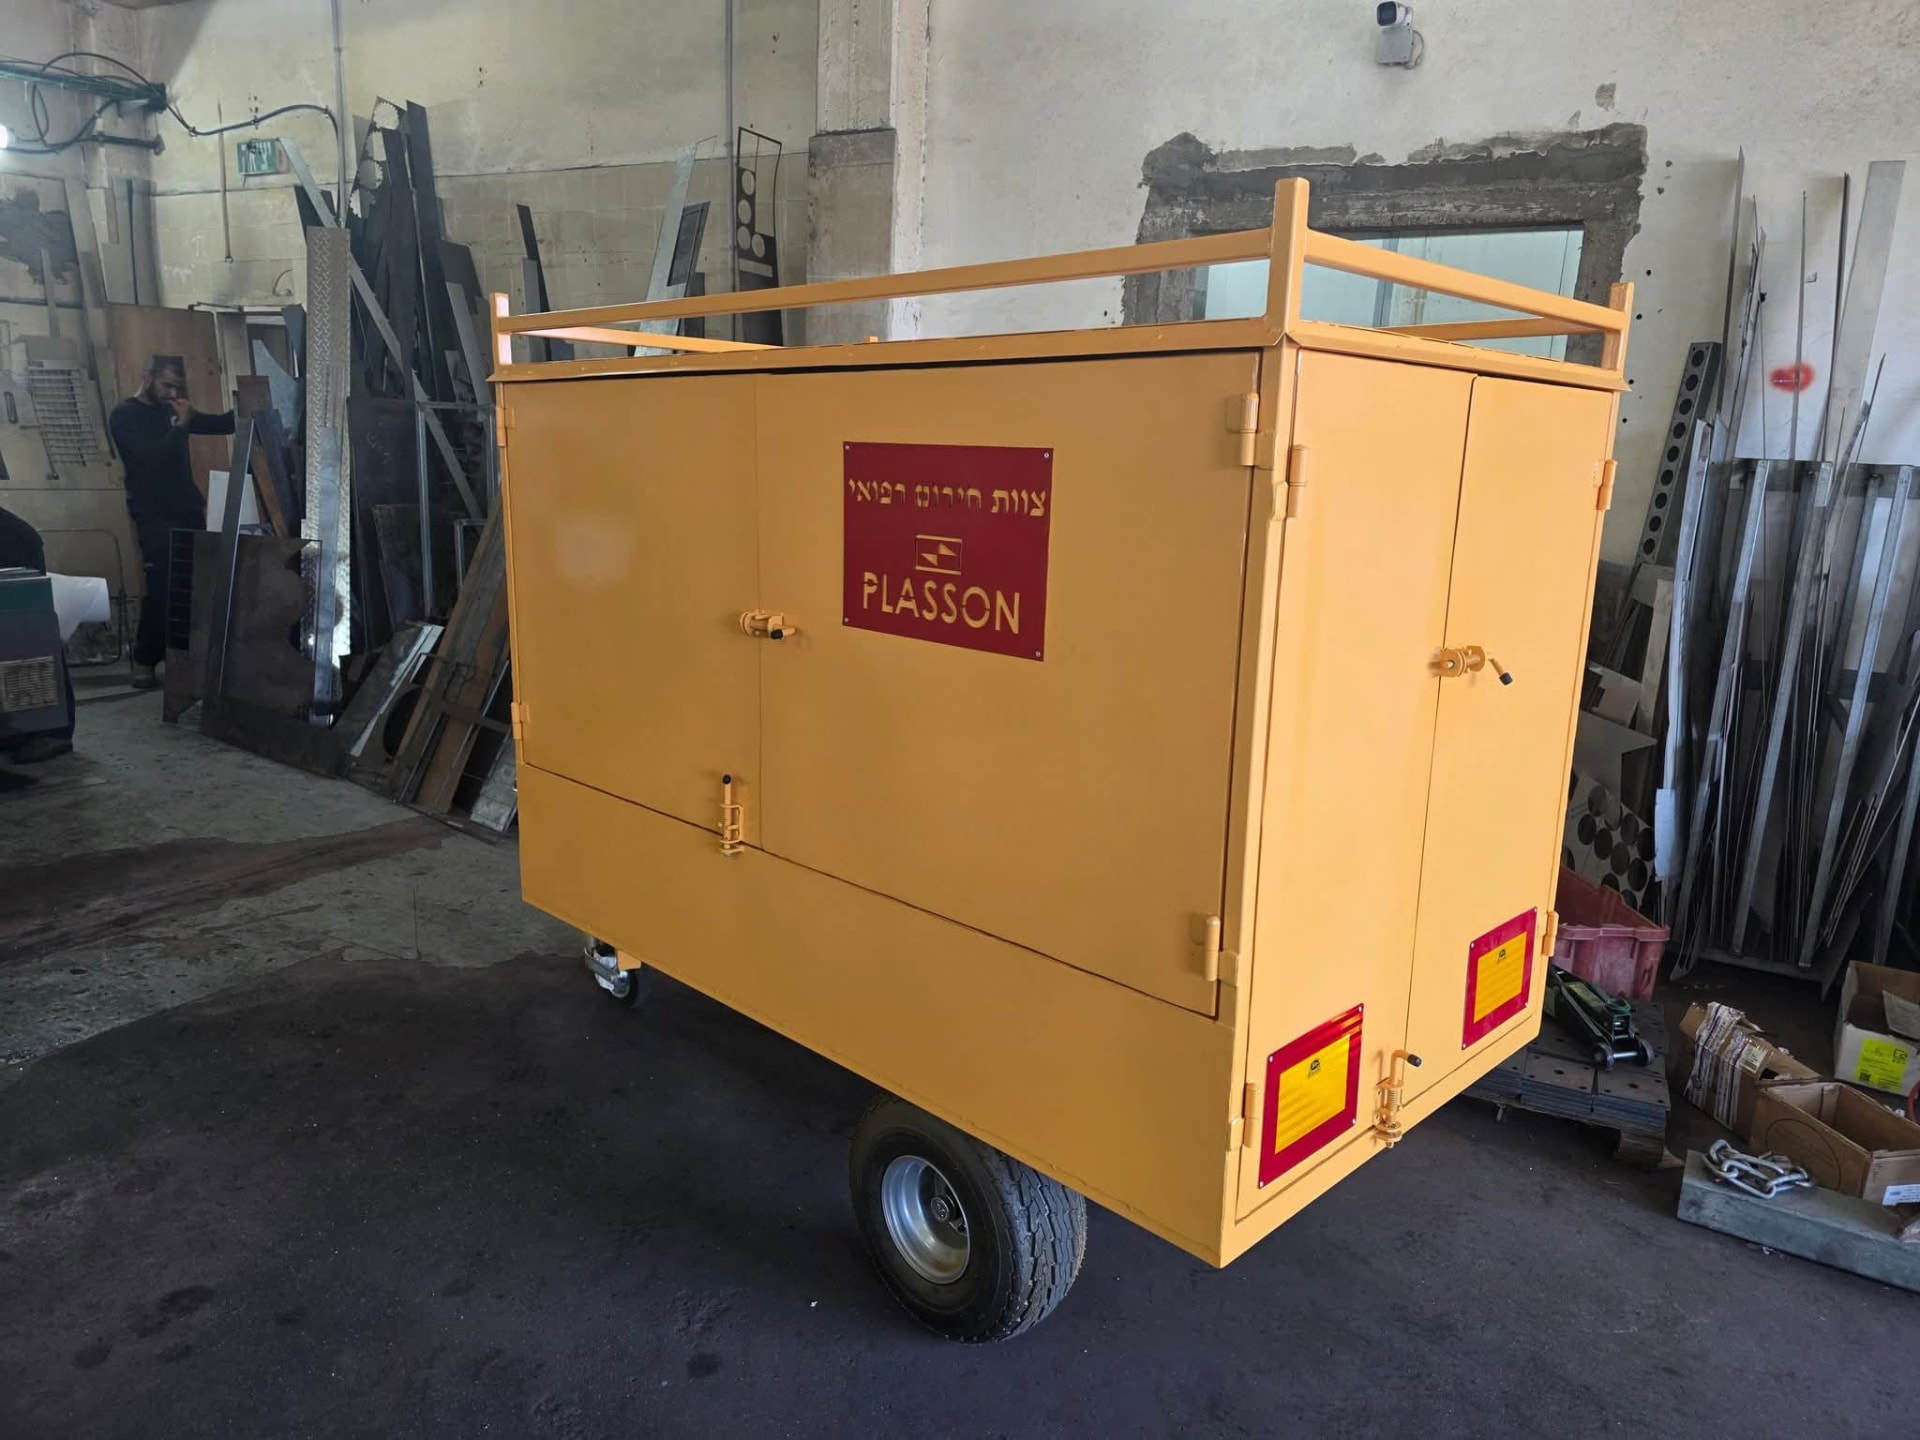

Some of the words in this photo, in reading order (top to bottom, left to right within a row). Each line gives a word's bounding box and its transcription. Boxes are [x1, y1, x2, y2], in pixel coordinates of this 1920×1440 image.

[848, 478, 906, 505] רפואי
[914, 484, 982, 510] חירום
[990, 488, 1047, 517] צוות
[863, 571, 1021, 635] PLASSON
